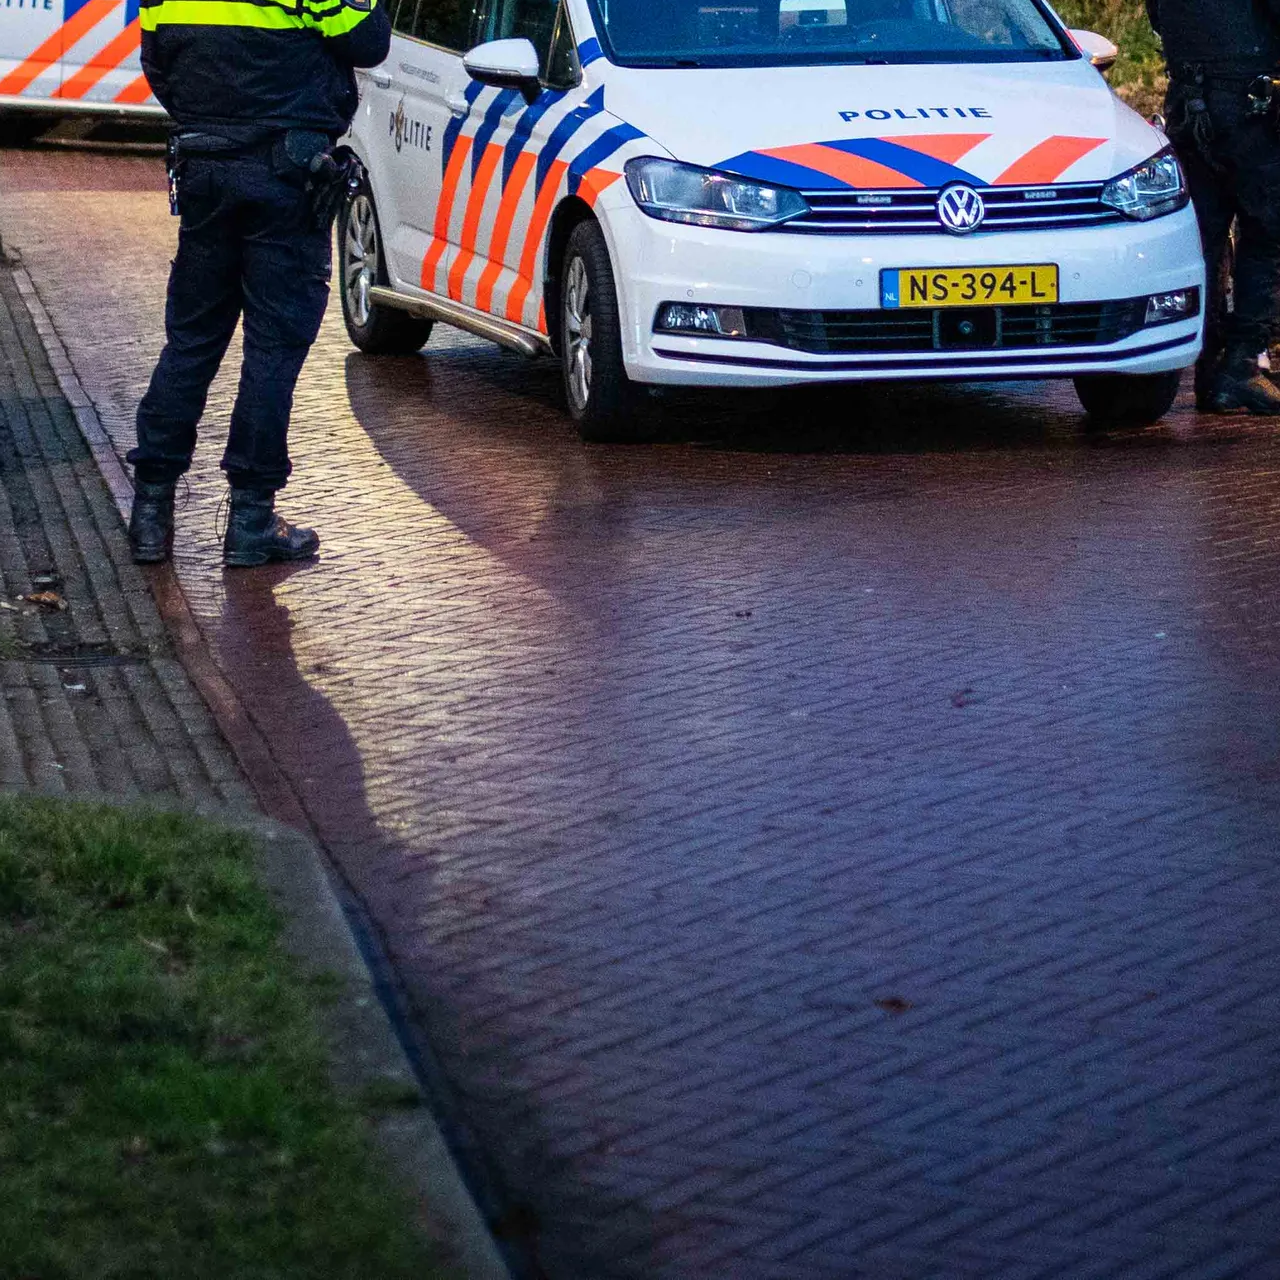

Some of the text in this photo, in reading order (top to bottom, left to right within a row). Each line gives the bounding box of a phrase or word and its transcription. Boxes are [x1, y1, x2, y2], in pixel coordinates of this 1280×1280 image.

[389, 103, 432, 153] POLITIE
[838, 107, 993, 122] POLITIE
[884, 271, 1046, 302] NL NS-394-L
